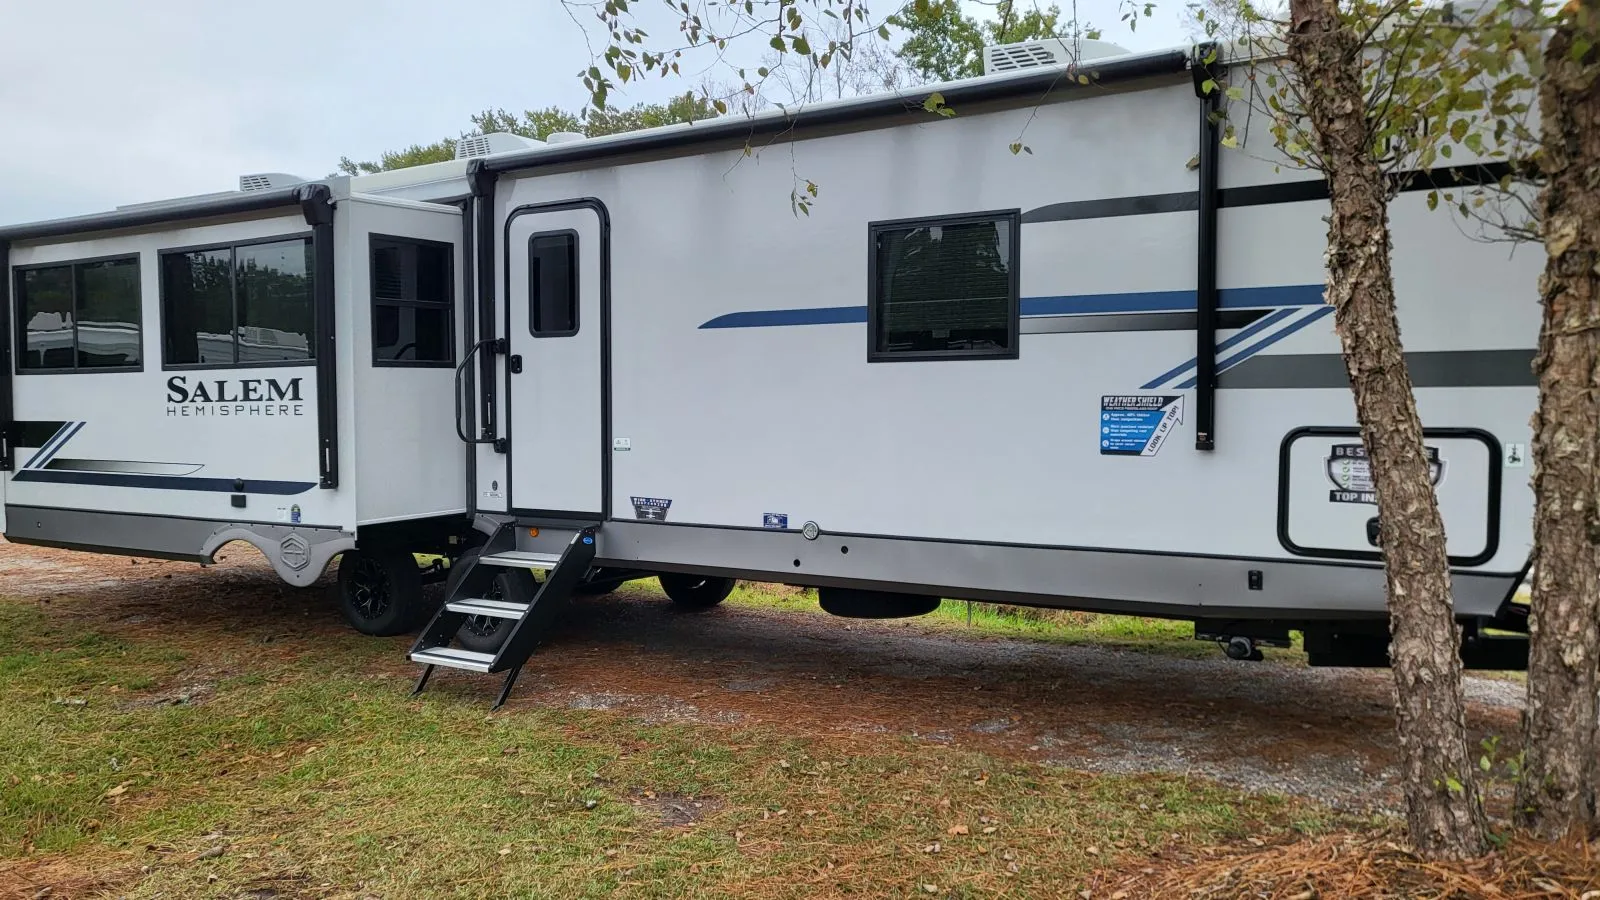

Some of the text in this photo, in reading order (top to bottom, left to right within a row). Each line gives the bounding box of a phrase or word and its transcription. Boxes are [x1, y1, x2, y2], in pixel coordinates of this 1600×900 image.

[167, 376, 303, 403] SALEM
[1103, 396, 1164, 407] WEATHER SHIELD
[167, 405, 303, 416] HEMISPHERE
[1147, 405, 1180, 452] LOOK UP TOP!
[1336, 447, 1365, 456] BES
[1334, 492, 1358, 502] TOP
